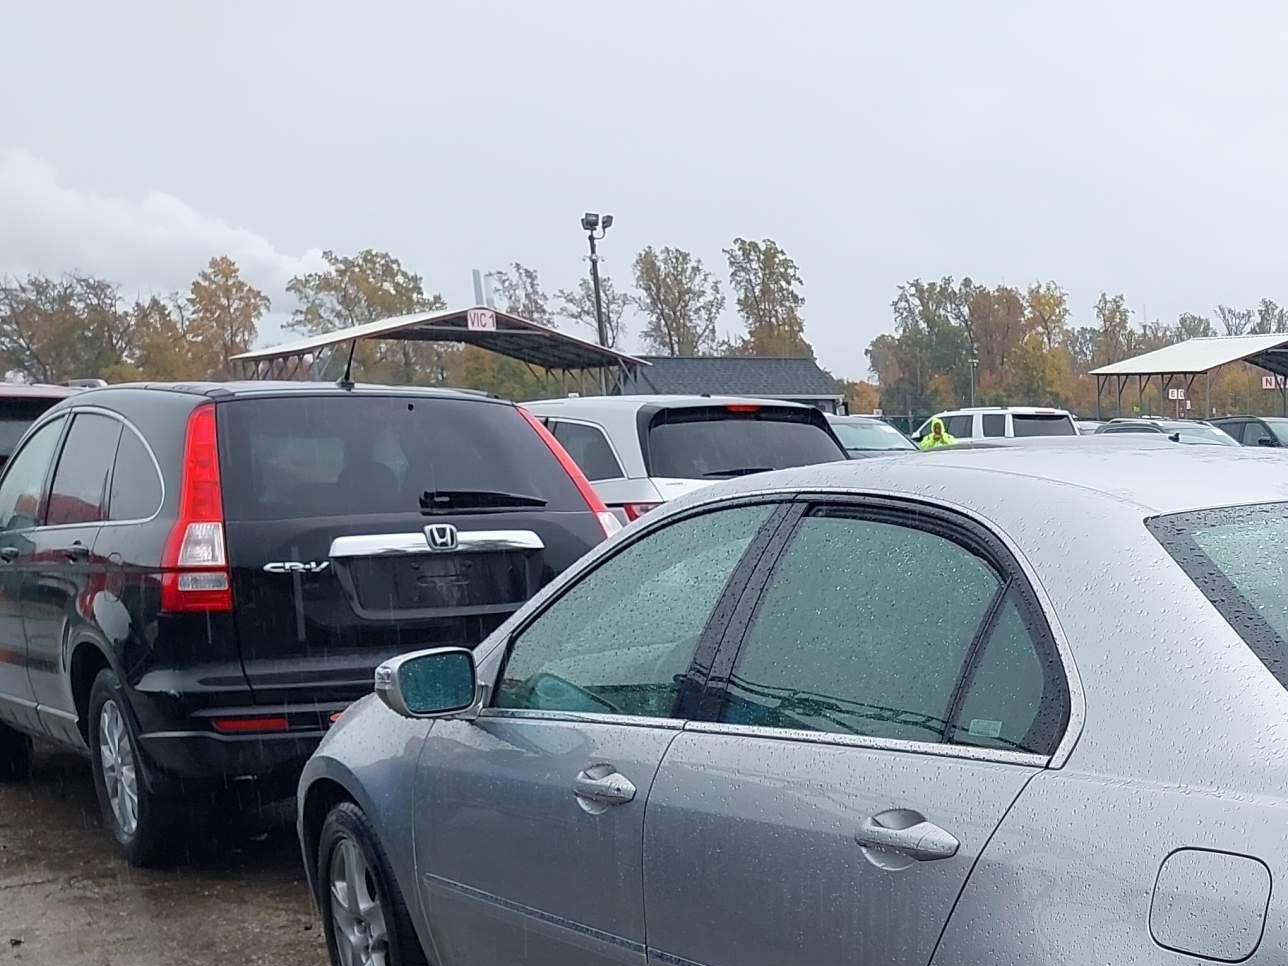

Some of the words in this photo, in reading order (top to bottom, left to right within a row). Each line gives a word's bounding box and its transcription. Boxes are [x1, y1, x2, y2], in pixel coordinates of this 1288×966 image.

[468, 311, 487, 328] VIC
[489, 313, 495, 328] 1
[262, 561, 330, 573] CR-V
